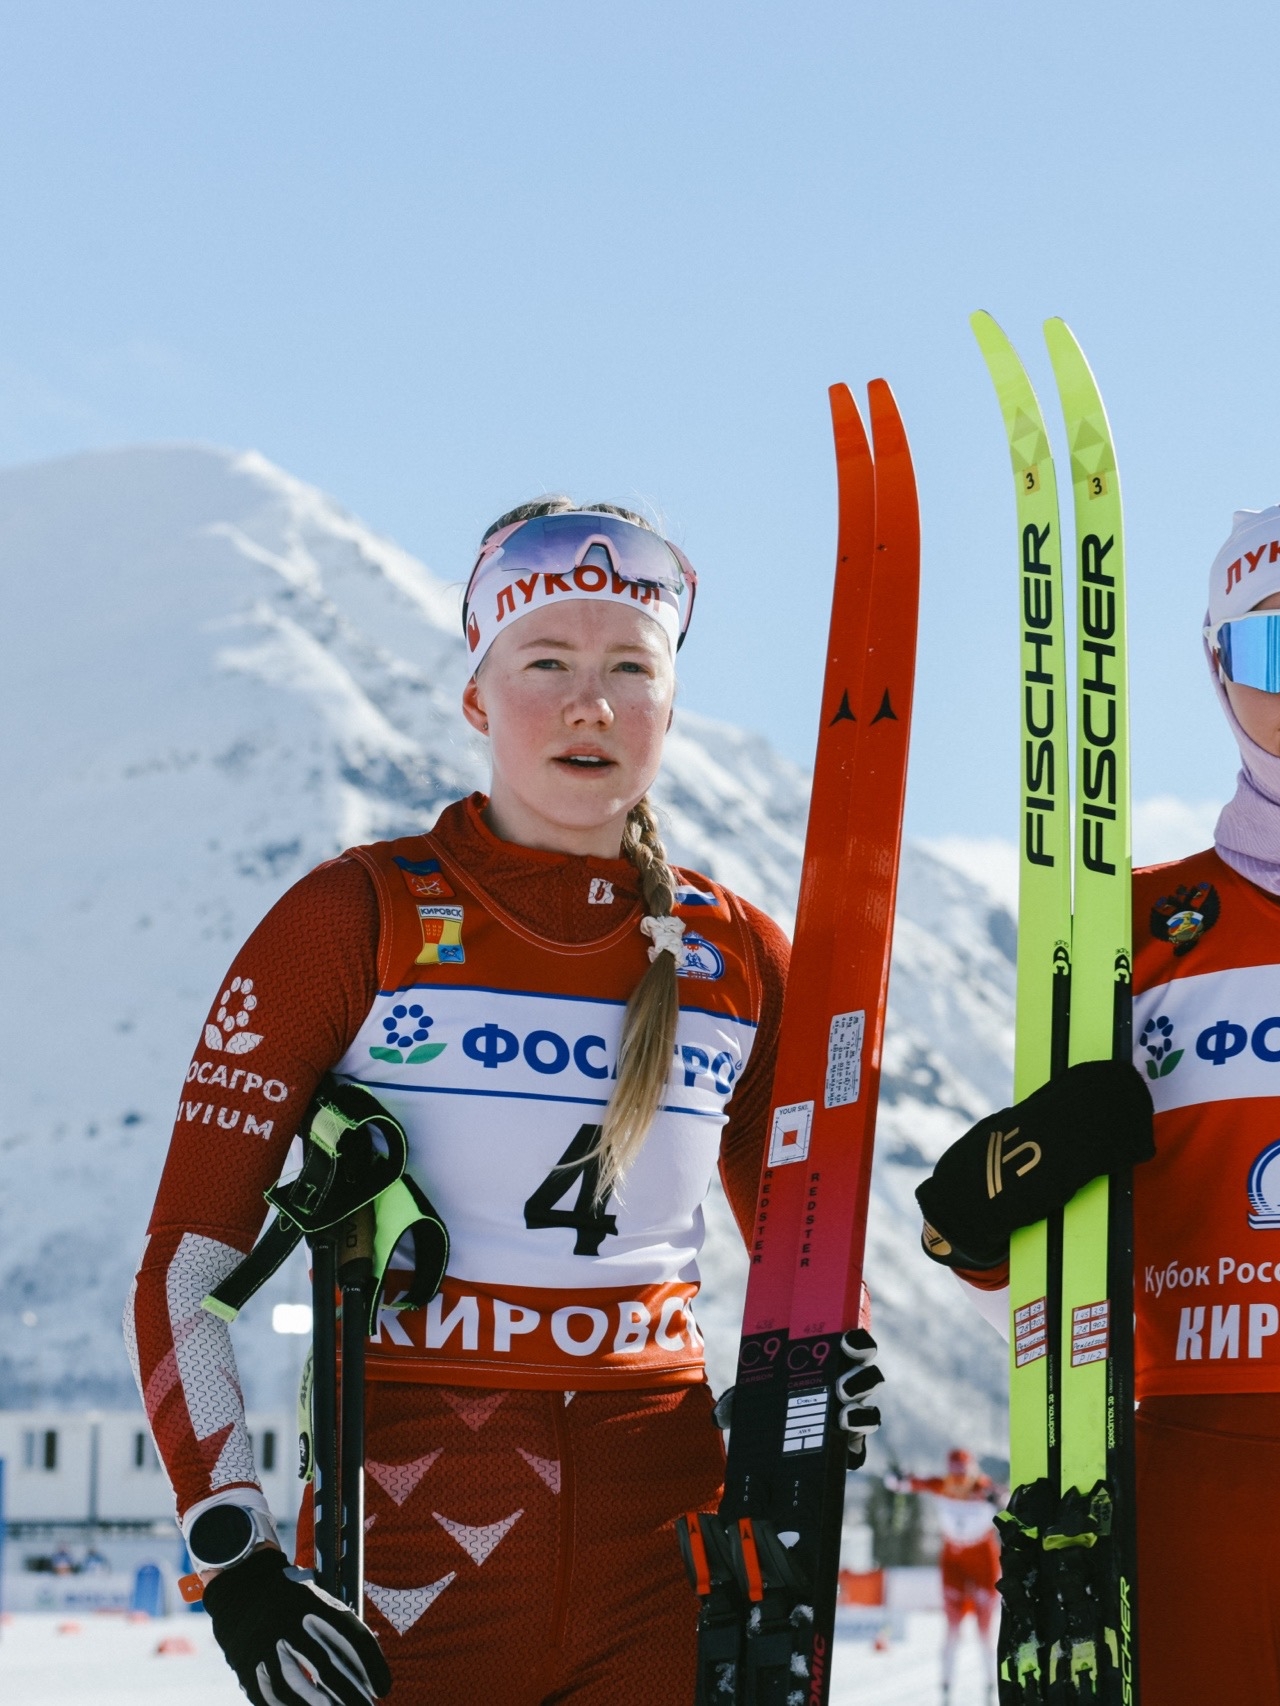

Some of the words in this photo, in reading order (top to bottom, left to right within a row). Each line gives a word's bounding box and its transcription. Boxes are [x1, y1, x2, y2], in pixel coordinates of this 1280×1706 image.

[1026, 472, 1035, 490] 3
[1092, 477, 1103, 495] 3
[1022, 521, 1055, 868] FISCHER
[1081, 533, 1117, 876] FISCHER
[420, 906, 463, 918] КИРОВСК
[462, 1023, 735, 1095] ФОСРО
[185, 1060, 289, 1103] ОСАГРО
[176, 1101, 274, 1141] IVIUM
[524, 1123, 619, 1257] 4
[752, 1170, 773, 1264] REDSTER
[800, 1173, 821, 1268] REDSTER
[1145, 1261, 1211, 1298] Кубок
[740, 1337, 781, 1367] C9
[787, 1341, 830, 1370] C9
[1048, 1404, 1056, 1448] speedmax
[1107, 1407, 1116, 1449] speedmax
[1120, 1576, 1132, 1706] SCHER
[809, 1632, 826, 1706] OMIC
